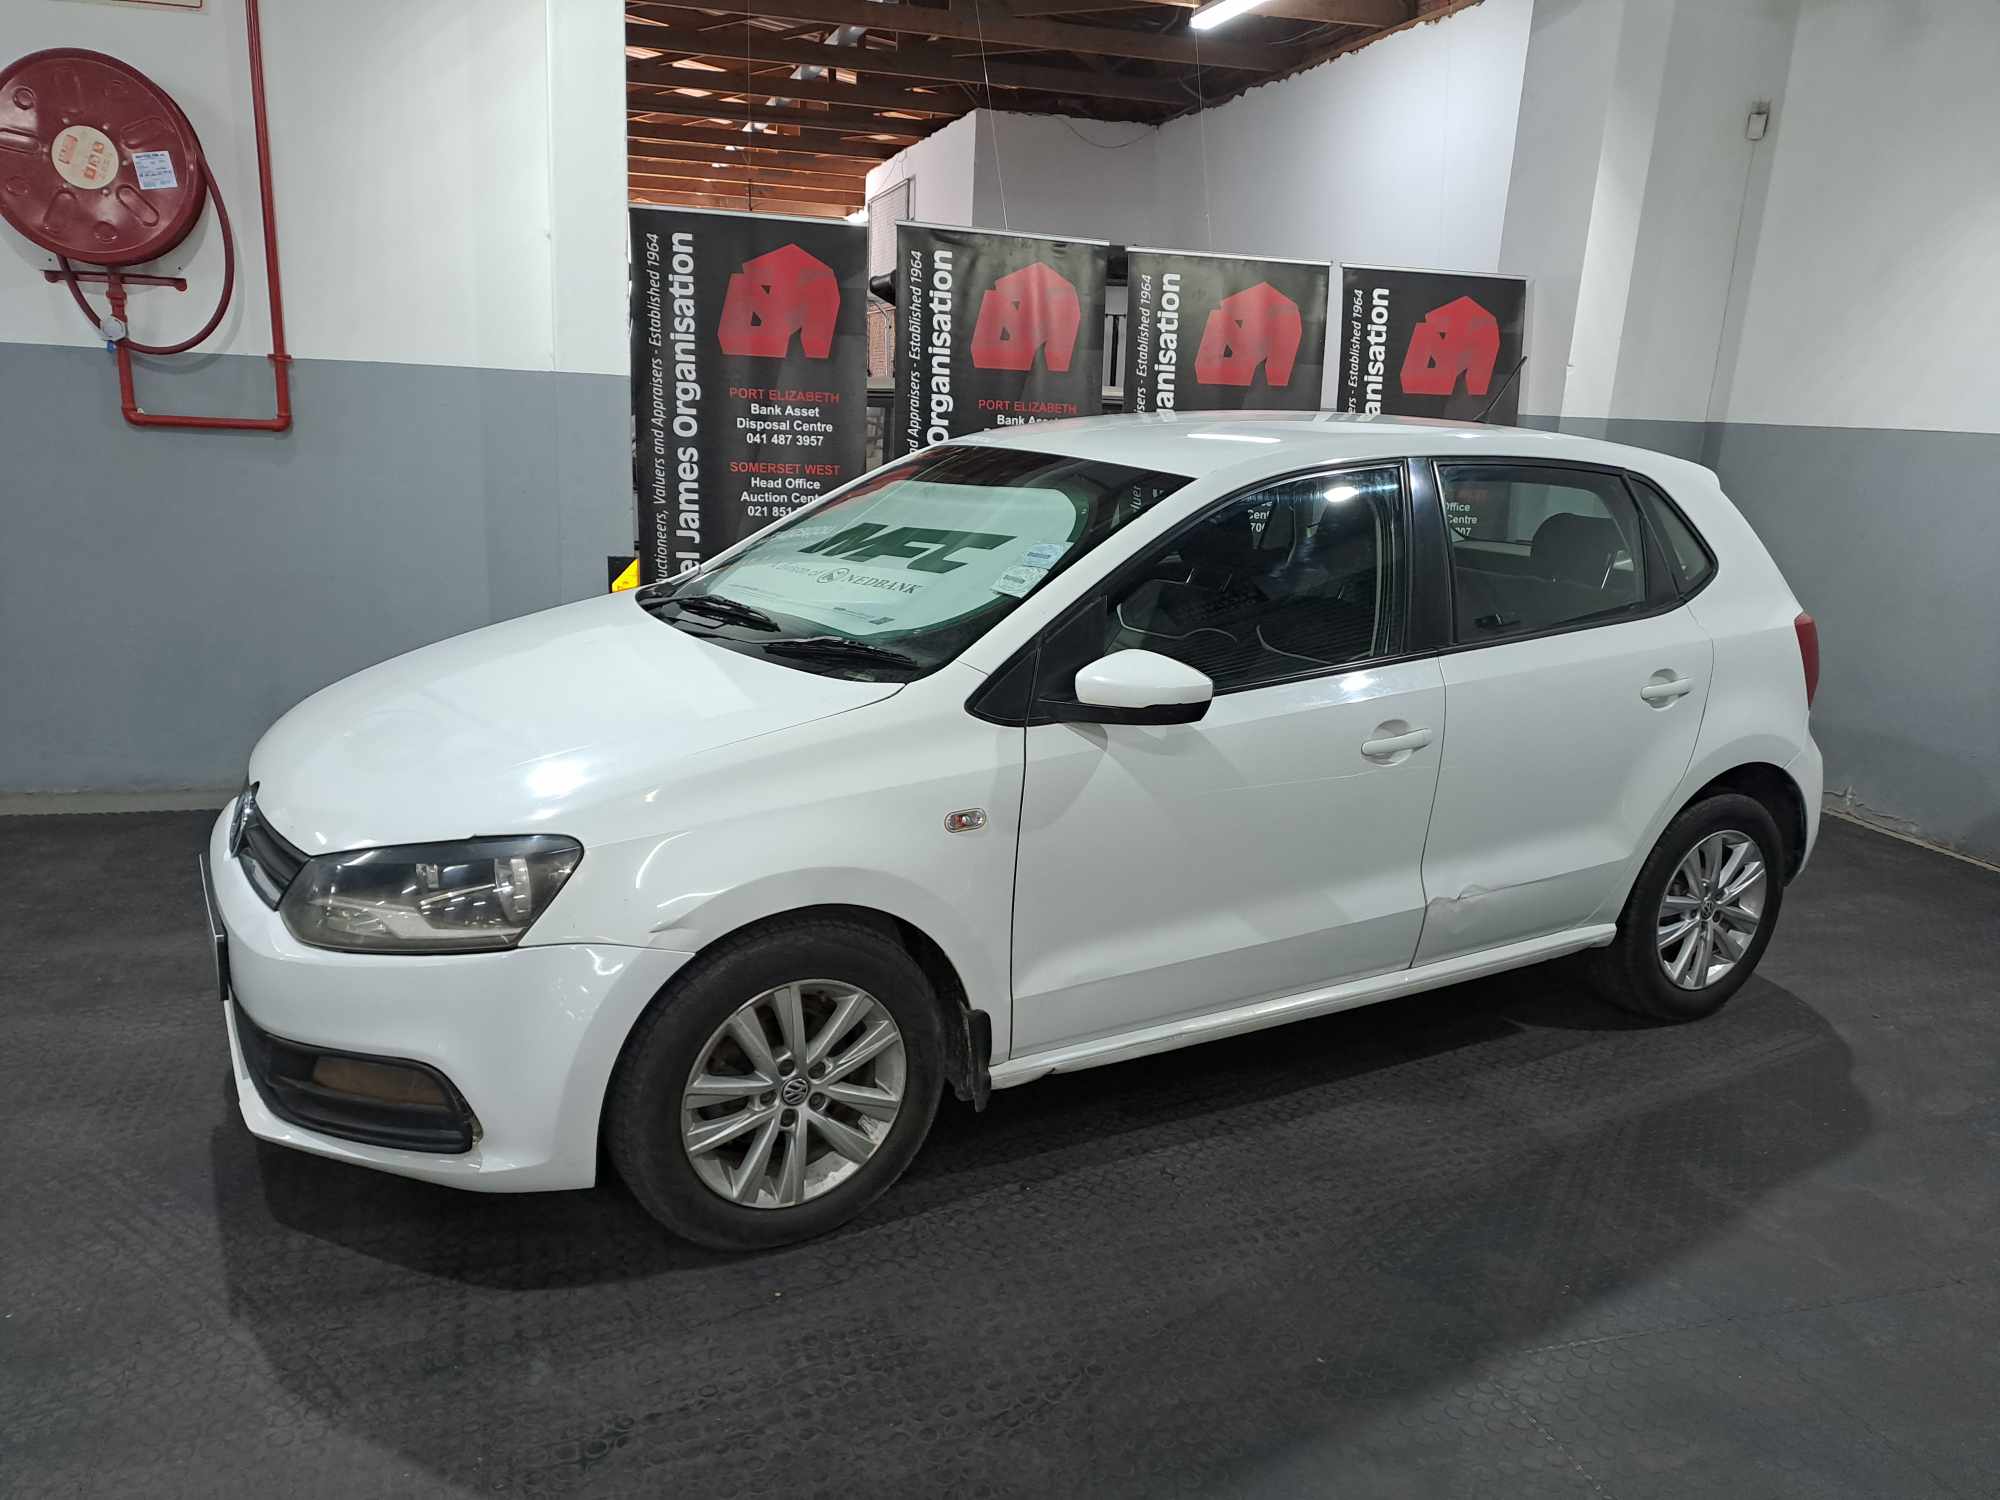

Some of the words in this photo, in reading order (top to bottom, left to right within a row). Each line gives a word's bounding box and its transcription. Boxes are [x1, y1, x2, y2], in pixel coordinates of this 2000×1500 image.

[646, 233, 660, 267] 1964
[910, 250, 923, 284] 1964
[1141, 274, 1152, 306] 1964
[1353, 288, 1363, 318] 1964
[646, 269, 662, 347] Established
[908, 285, 922, 360] Established
[668, 232, 702, 438] Organisation
[926, 250, 953, 446] Organisation
[1136, 306, 1151, 377] Established
[1154, 272, 1181, 412] anisation
[1347, 319, 1361, 388] Established
[650, 357, 667, 427] Appraisers
[729, 387, 764, 399] PORT
[769, 389, 840, 403] ELIZABETH
[907, 369, 922, 438] Appraisers
[978, 399, 1009, 411] PORT
[1014, 401, 1077, 414] ELIZABETH
[736, 417, 790, 432] Disposal
[793, 420, 833, 433] Centre
[750, 403, 782, 416] Bank
[784, 405, 820, 418] Asset
[996, 414, 1025, 425] Bank
[652, 428, 664, 456] and
[746, 433, 767, 444] 041
[770, 434, 793, 445] 487
[796, 434, 824, 447] 3957
[652, 458, 665, 505] Valuers
[729, 461, 801, 475] SOMERSET
[804, 463, 841, 476] WEST
[750, 477, 783, 489] Head
[785, 478, 821, 490] Office
[676, 447, 700, 544] James
[740, 491, 788, 504] Auction
[747, 504, 768, 517] 021
[771, 506, 792, 517] 851
[655, 510, 669, 582] uctioneers,
[797, 522, 1018, 574] MFC
[845, 574, 921, 595] NEDBANK
